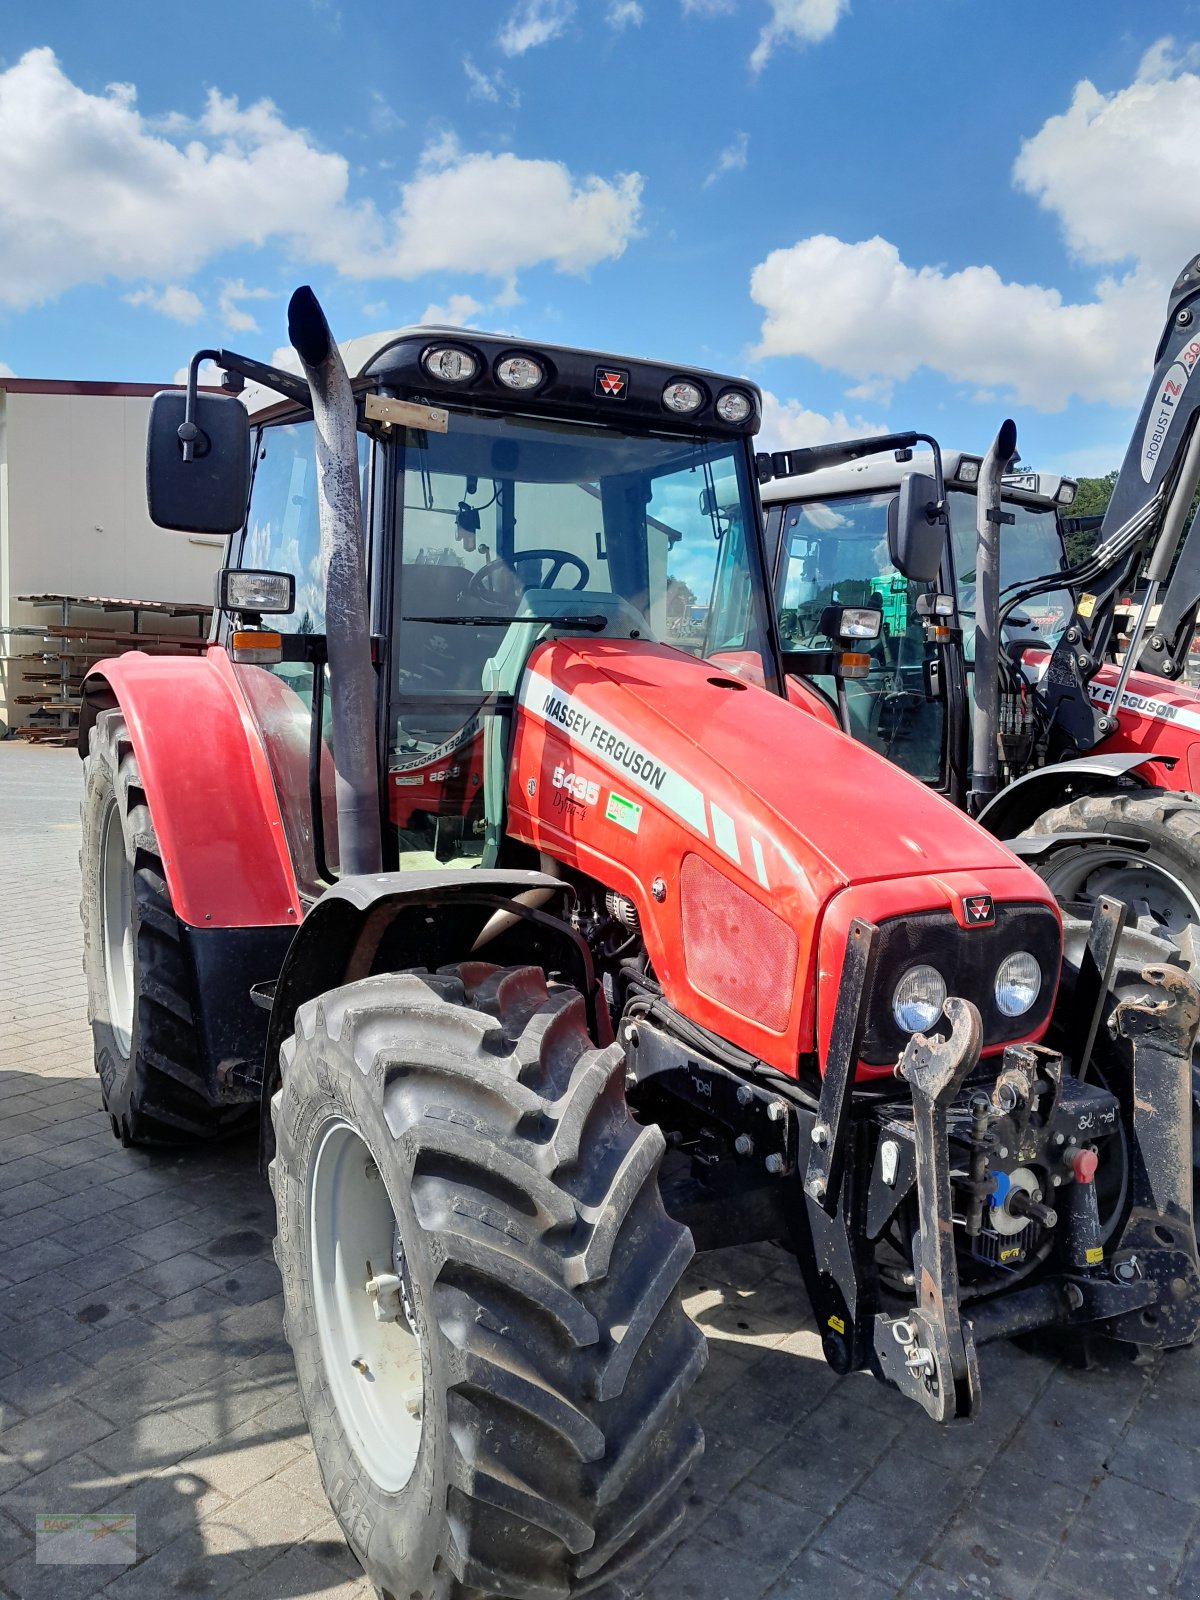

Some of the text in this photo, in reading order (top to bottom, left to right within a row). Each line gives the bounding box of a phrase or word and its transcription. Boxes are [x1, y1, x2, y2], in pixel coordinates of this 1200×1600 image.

[1146, 409, 1171, 461] ROBUST
[1161, 379, 1181, 408] FZ
[1102, 689, 1178, 719] FRGUSON
[542, 694, 666, 790] MASSEY FERGUSON
[552, 766, 600, 806] 5435
